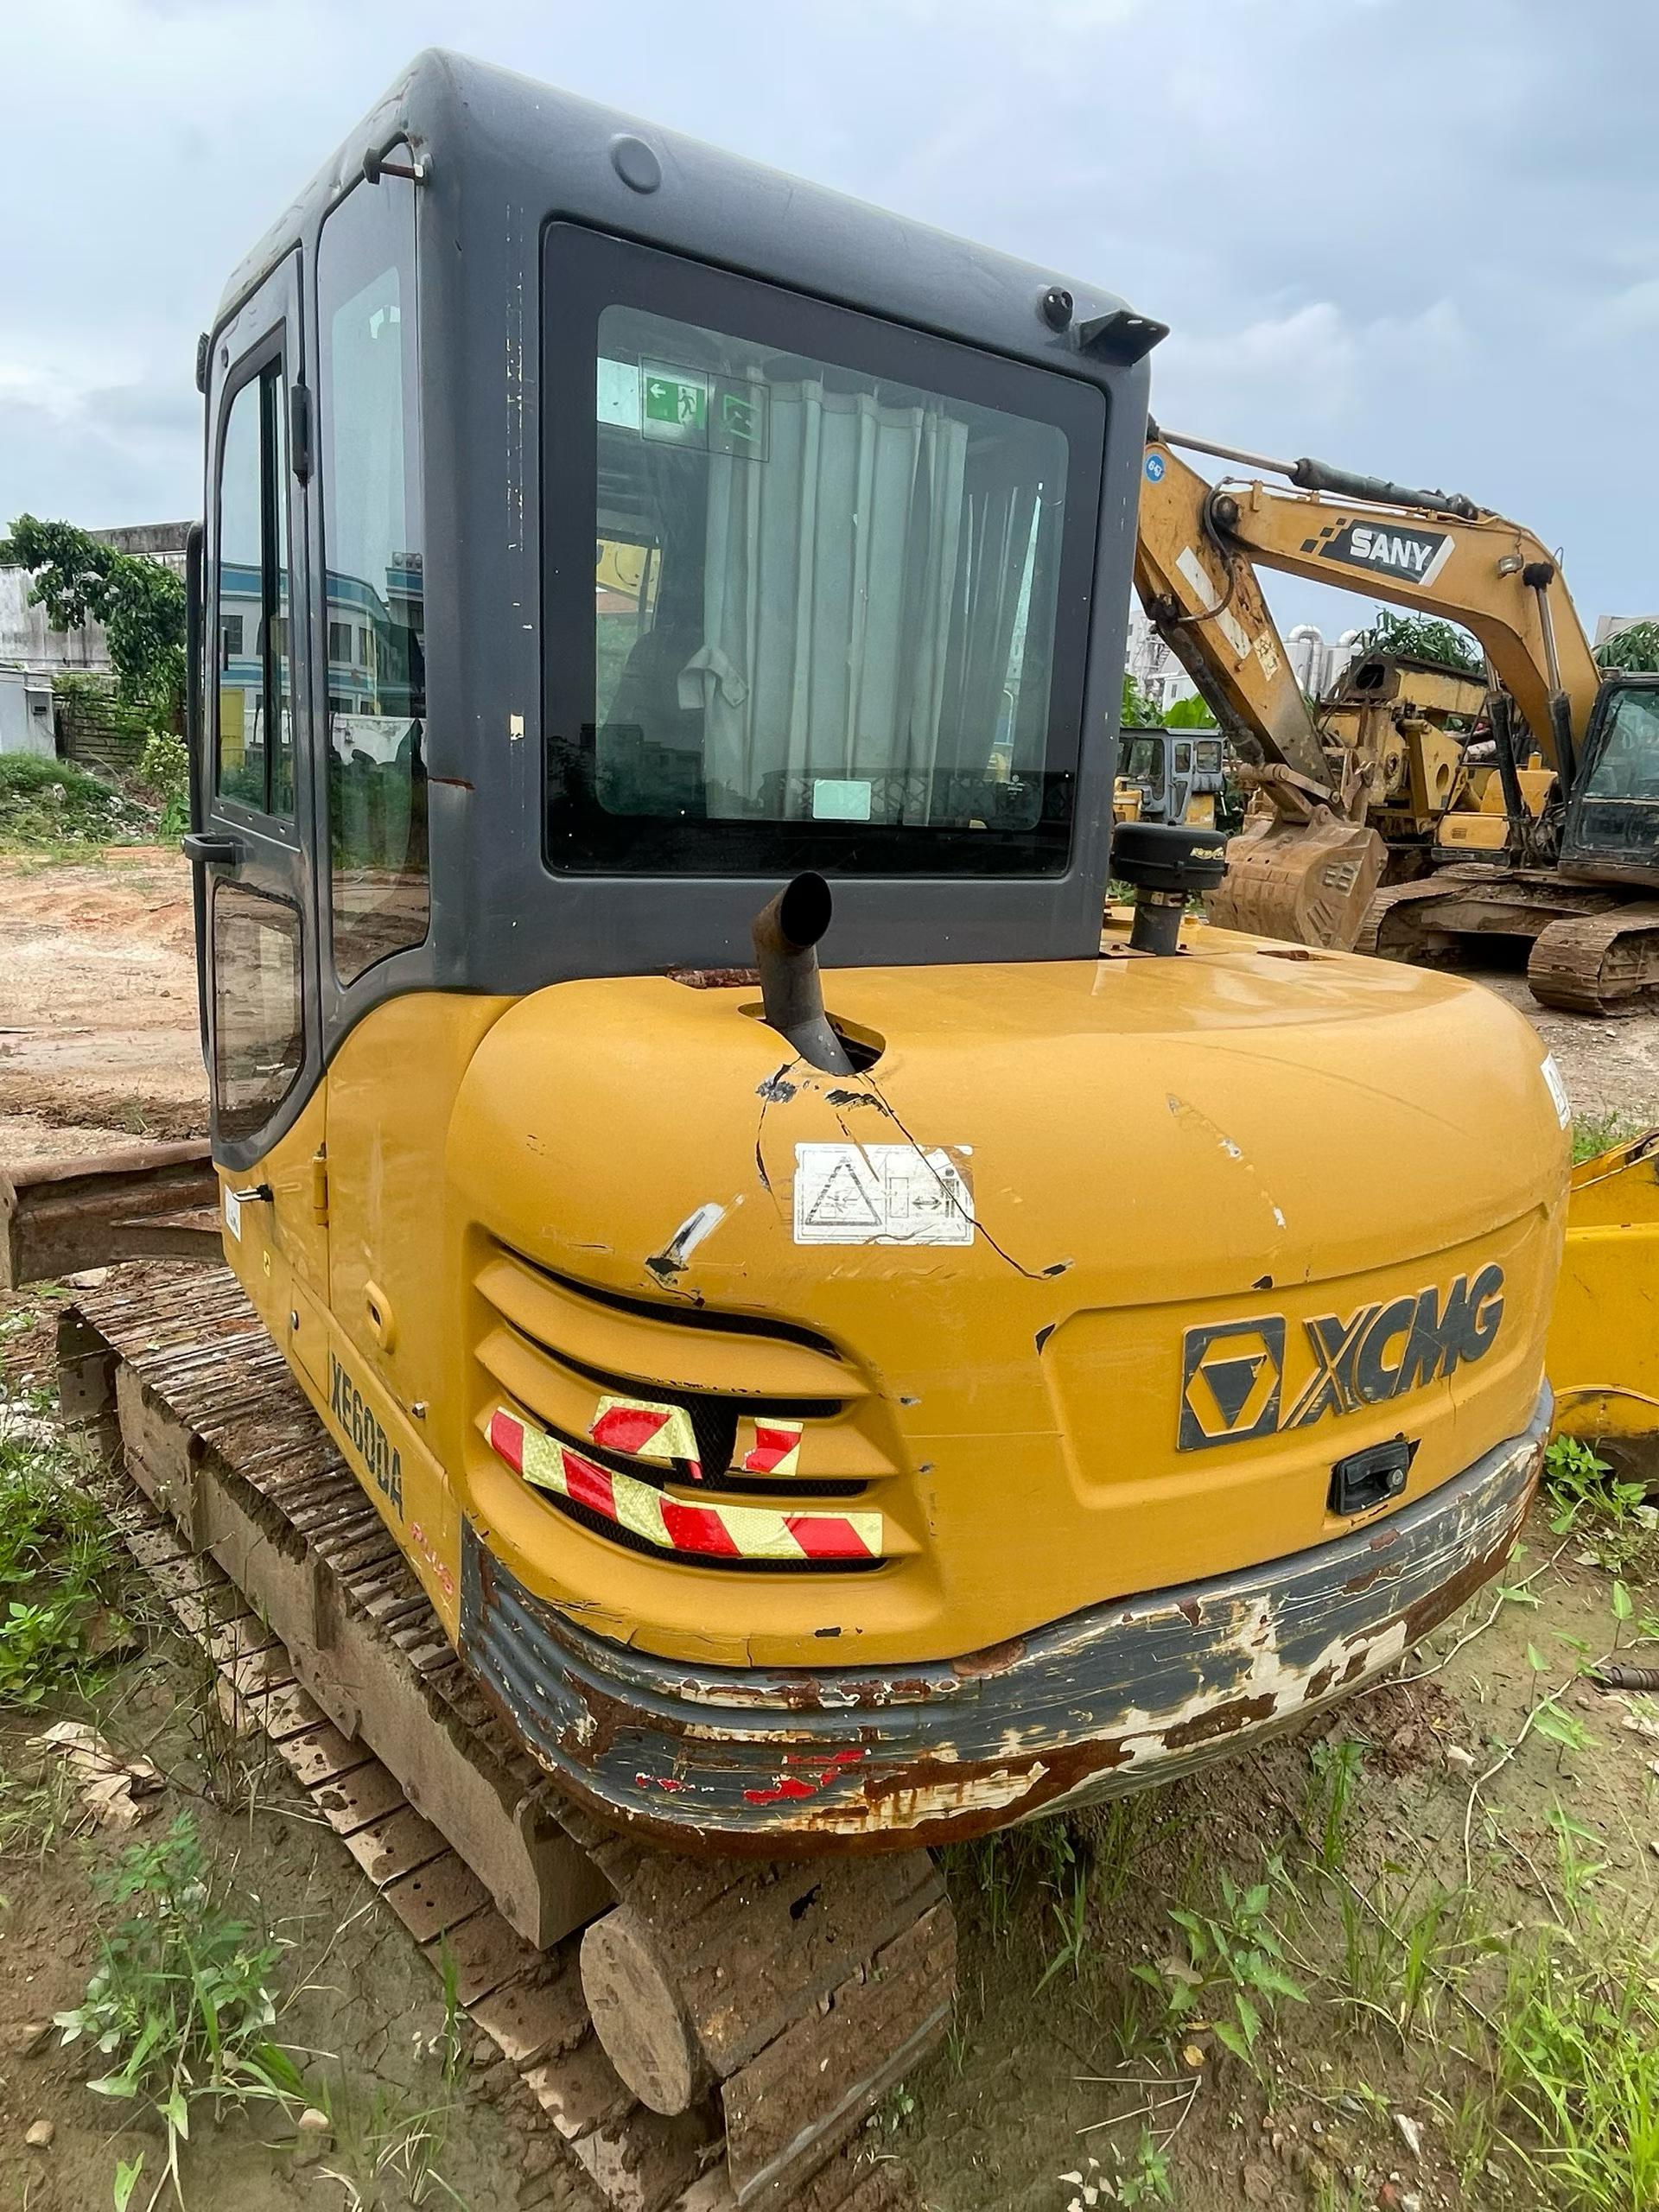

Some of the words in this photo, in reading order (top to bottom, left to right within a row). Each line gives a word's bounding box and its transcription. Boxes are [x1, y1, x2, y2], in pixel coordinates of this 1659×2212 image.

[1350, 527, 1433, 571] SANY
[1278, 1262, 1505, 1432] XCMG
[331, 1351, 404, 1525] XE60DA
